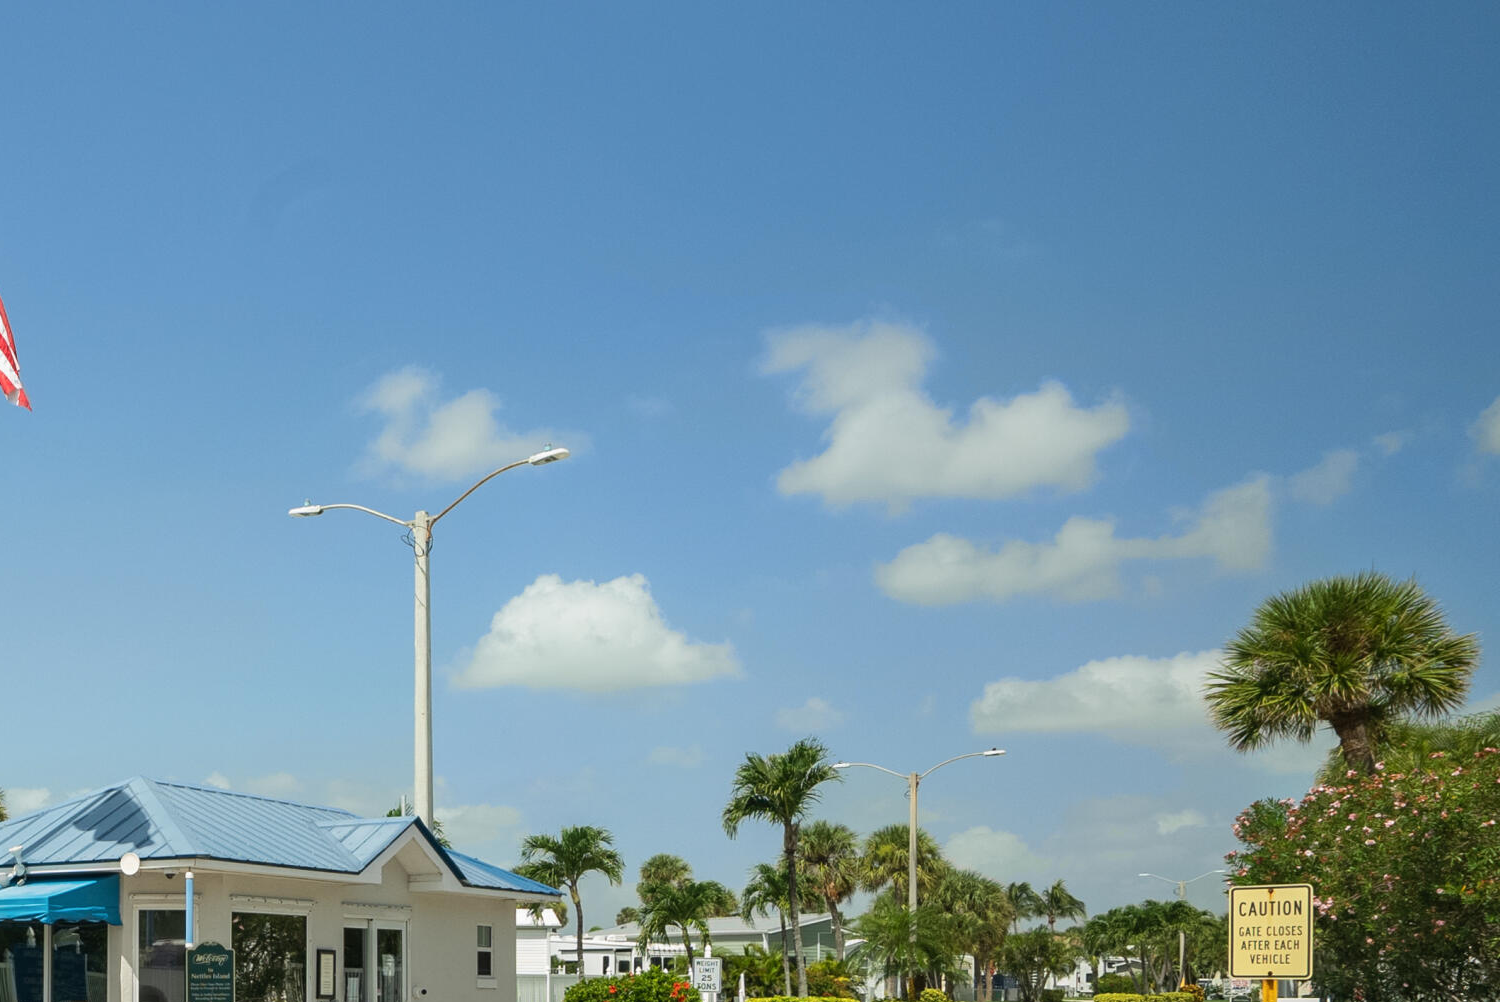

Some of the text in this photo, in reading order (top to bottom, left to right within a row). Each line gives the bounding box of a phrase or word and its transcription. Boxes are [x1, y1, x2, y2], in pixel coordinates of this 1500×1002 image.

[1239, 901, 1302, 916] CAUTION
[1239, 926, 1303, 937] GATE CLOSES
[1241, 940, 1300, 950] AFTER EACH
[193, 954, 228, 966] Welcome
[1250, 954, 1291, 964] VEHICLE
